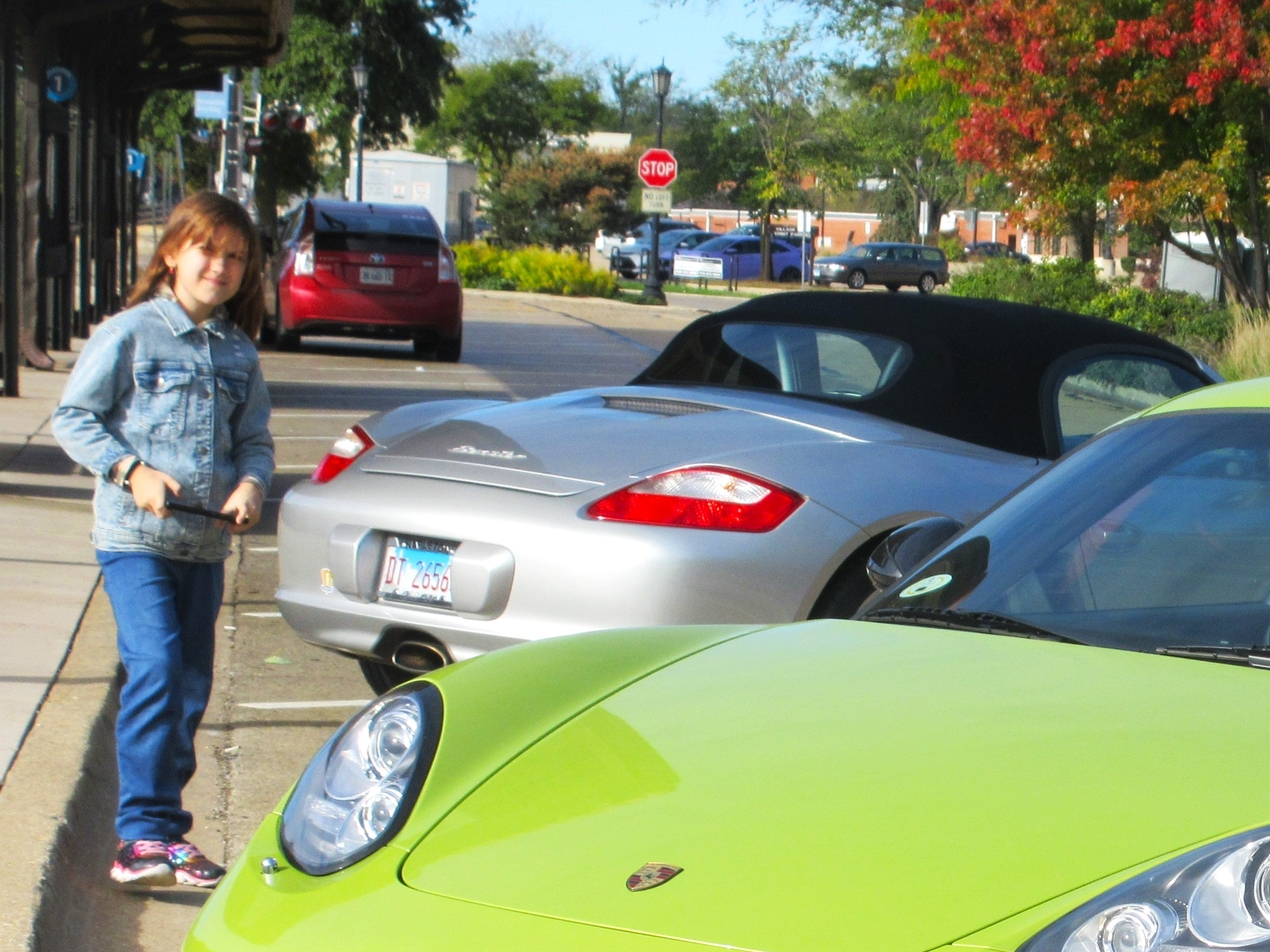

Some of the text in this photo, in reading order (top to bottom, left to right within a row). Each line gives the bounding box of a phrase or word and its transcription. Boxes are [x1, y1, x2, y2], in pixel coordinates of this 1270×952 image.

[641, 160, 674, 177] STOP
[644, 192, 654, 200] NO
[385, 555, 452, 592] DT 2656
